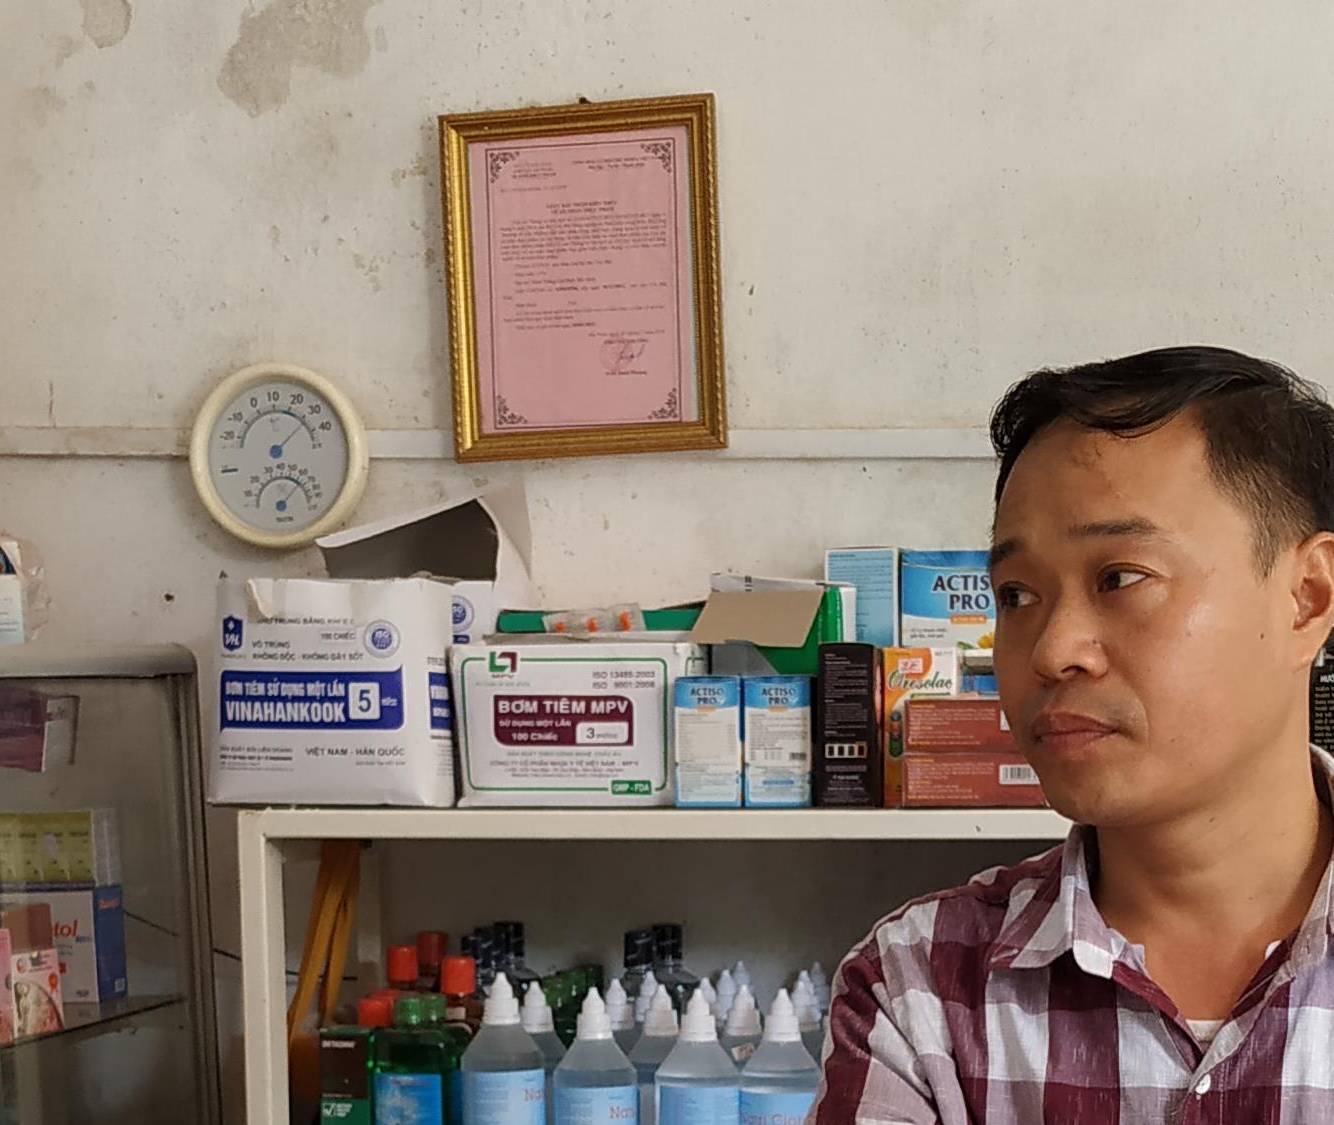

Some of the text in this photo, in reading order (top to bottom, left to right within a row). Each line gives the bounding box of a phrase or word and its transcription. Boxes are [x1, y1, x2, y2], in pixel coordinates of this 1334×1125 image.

[267, 392, 280, 402] 10
[290, 394, 304, 405] 20
[308, 404, 321, 416] 30
[319, 421, 332, 431] 40
[933, 574, 992, 593] ACTIS
[949, 594, 991, 611] PRO
[593, 671, 607, 679] ISO
[593, 681, 607, 690] ISO
[690, 687, 724, 697] ACTISO
[762, 687, 796, 697] ACTISO
[225, 689, 372, 723] VINAHANKOOK 5
[498, 698, 629, 714] BƠM TIÊM MPV
[697, 697, 718, 705] PRO
[768, 697, 790, 705] PRO
[586, 728, 595, 739] 3
[328, 748, 348, 757] NAM
